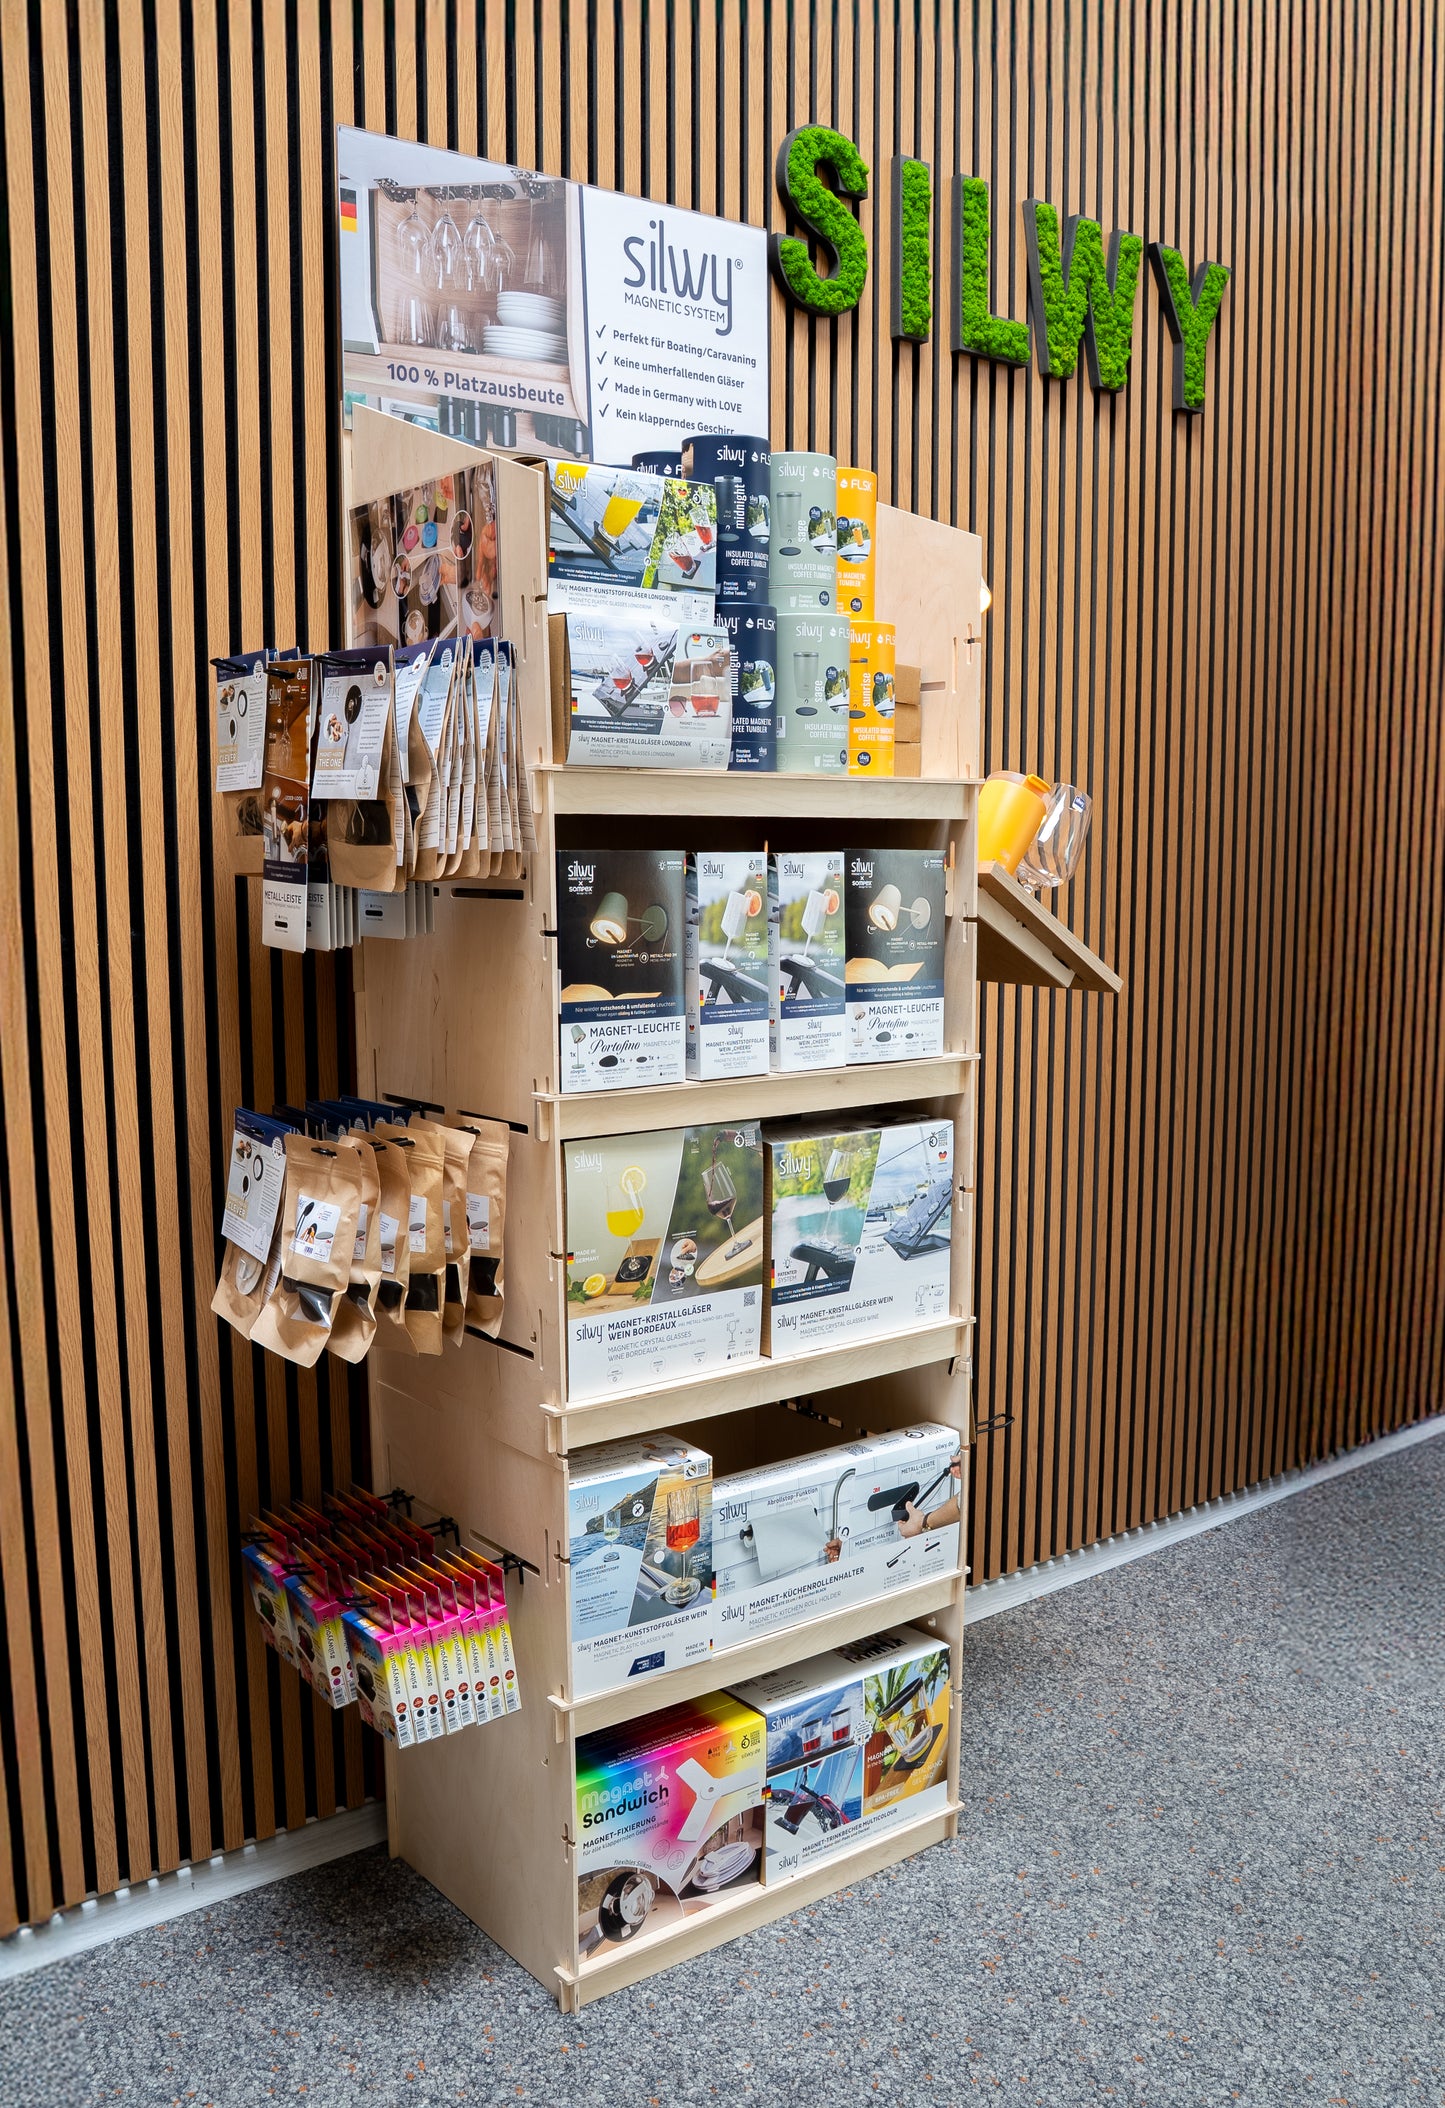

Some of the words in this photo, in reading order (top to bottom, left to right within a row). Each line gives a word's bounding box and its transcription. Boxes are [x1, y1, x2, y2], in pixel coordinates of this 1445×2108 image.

[768, 124, 1232, 414] SILWY
[624, 291, 682, 315] MAGNETIC
[684, 304, 726, 324] SYSTEM
[613, 329, 649, 346] Perfekt
[651, 337, 665, 349] für
[667, 340, 757, 368] Boating/Caravaning
[613, 356, 640, 370] Keine
[642, 360, 715, 383] umherfallenden
[717, 375, 745, 389] Gläser
[386, 363, 419, 383] 100
[424, 369, 440, 386] %
[444, 371, 565, 406] Platzausbeute
[614, 382, 640, 396] Made
[642, 387, 651, 397] in
[653, 389, 694, 407] Germany
[695, 395, 717, 409] with
[719, 400, 743, 413] LOVE
[616, 408, 637, 421] Kein
[639, 409, 695, 430] klapperndes
[697, 421, 735, 435] Geschirr
[717, 445, 746, 468] silwy
[778, 462, 807, 482] silwy
[558, 470, 588, 497] silwy
[733, 483, 747, 530] midnight
[798, 519, 808, 543] sage
[725, 550, 754, 559] INSULATED
[730, 558, 750, 567] COFFEE
[568, 584, 648, 599] MAGNET-KUNSTSTOFFGLÄSER
[648, 592, 678, 602] LONGDRINK
[575, 622, 604, 647] silwy
[795, 622, 824, 642] silwy
[814, 679, 825, 703] sage
[862, 672, 871, 707] sunrise
[591, 736, 662, 746] MAGNET-KRISTALLGLÄSER
[219, 752, 236, 763] CLEVER
[319, 758, 330, 767] THE
[330, 758, 342, 767] ONE
[568, 860, 595, 883] silwy
[703, 860, 724, 879] silwy
[784, 859, 804, 878] silwy
[851, 858, 875, 878] silwy
[264, 890, 302, 905] METALL-LEISTE
[868, 1003, 940, 1015] MAGNET-LEUCHTE
[590, 1021, 681, 1037] MAGNET-LEUCHTE
[727, 1024, 744, 1038] silwy
[807, 1018, 824, 1032] silwy
[867, 1016, 909, 1031] Portofino
[705, 1038, 765, 1048] MAGNET-KUNSTSTOFFGLAS
[785, 1031, 842, 1041] MAGNET-KUNSTSTOFFGLAS
[588, 1039, 641, 1055] Portofino
[574, 1150, 603, 1173] silwy
[779, 1153, 812, 1180] silwy
[227, 1201, 246, 1217] CLEVER
[777, 1315, 798, 1331] silwy
[800, 1298, 877, 1321] MAGNET-KRISTALLGLÄSER
[877, 1295, 894, 1305] WEIN
[576, 1323, 604, 1344] silwy
[608, 1303, 712, 1332] MAGNET-KRISTALLGLÄSER
[608, 1330, 631, 1341] WEIN
[632, 1320, 677, 1337] BORDEAUX
[607, 1340, 639, 1353] MAGNETIC
[640, 1335, 665, 1347] CRYSTAL
[665, 1330, 692, 1342] GLASSES
[607, 1353, 625, 1361] WINE
[625, 1346, 659, 1359] BORDEAUX
[935, 1441, 954, 1450] silwy.de
[901, 1460, 936, 1475] METALL-LEISTE
[575, 1494, 600, 1511] silwy
[767, 1487, 818, 1506] Abrollstop-Funktion
[719, 1501, 748, 1524] silwy
[854, 1530, 895, 1548] MAGNET-HALTER
[721, 1605, 746, 1622] silwy
[749, 1566, 865, 1610] MAGNET-KÜCHENROLLENHALTER
[748, 1612, 779, 1626] MAGNETIC
[779, 1603, 804, 1616] KITCHEN
[804, 1599, 819, 1608] ROLL
[818, 1590, 842, 1603] HOLDER
[577, 1640, 593, 1653] silwy
[593, 1613, 690, 1648] MAGNET-KUNSTSTOFFGLÄSER
[690, 1610, 708, 1620] WEIN
[685, 1648, 707, 1657] GERMANY
[771, 1714, 794, 1732] silwy
[581, 1770, 652, 1811] Magnet
[582, 1785, 670, 1829] Sandwich
[582, 1814, 657, 1849] MAGNET-FIXIERUNG
[582, 1848, 592, 1856] für
[592, 1845, 602, 1853] alle
[602, 1832, 636, 1852] klappernden
[636, 1818, 669, 1839] Gegenstände
[778, 1853, 799, 1871] silwy
[802, 1823, 862, 1853] MAGNET-TRINKBECHER
[862, 1807, 898, 1827] MULTICOLOUR
[613, 1859, 636, 1867] flexibles
